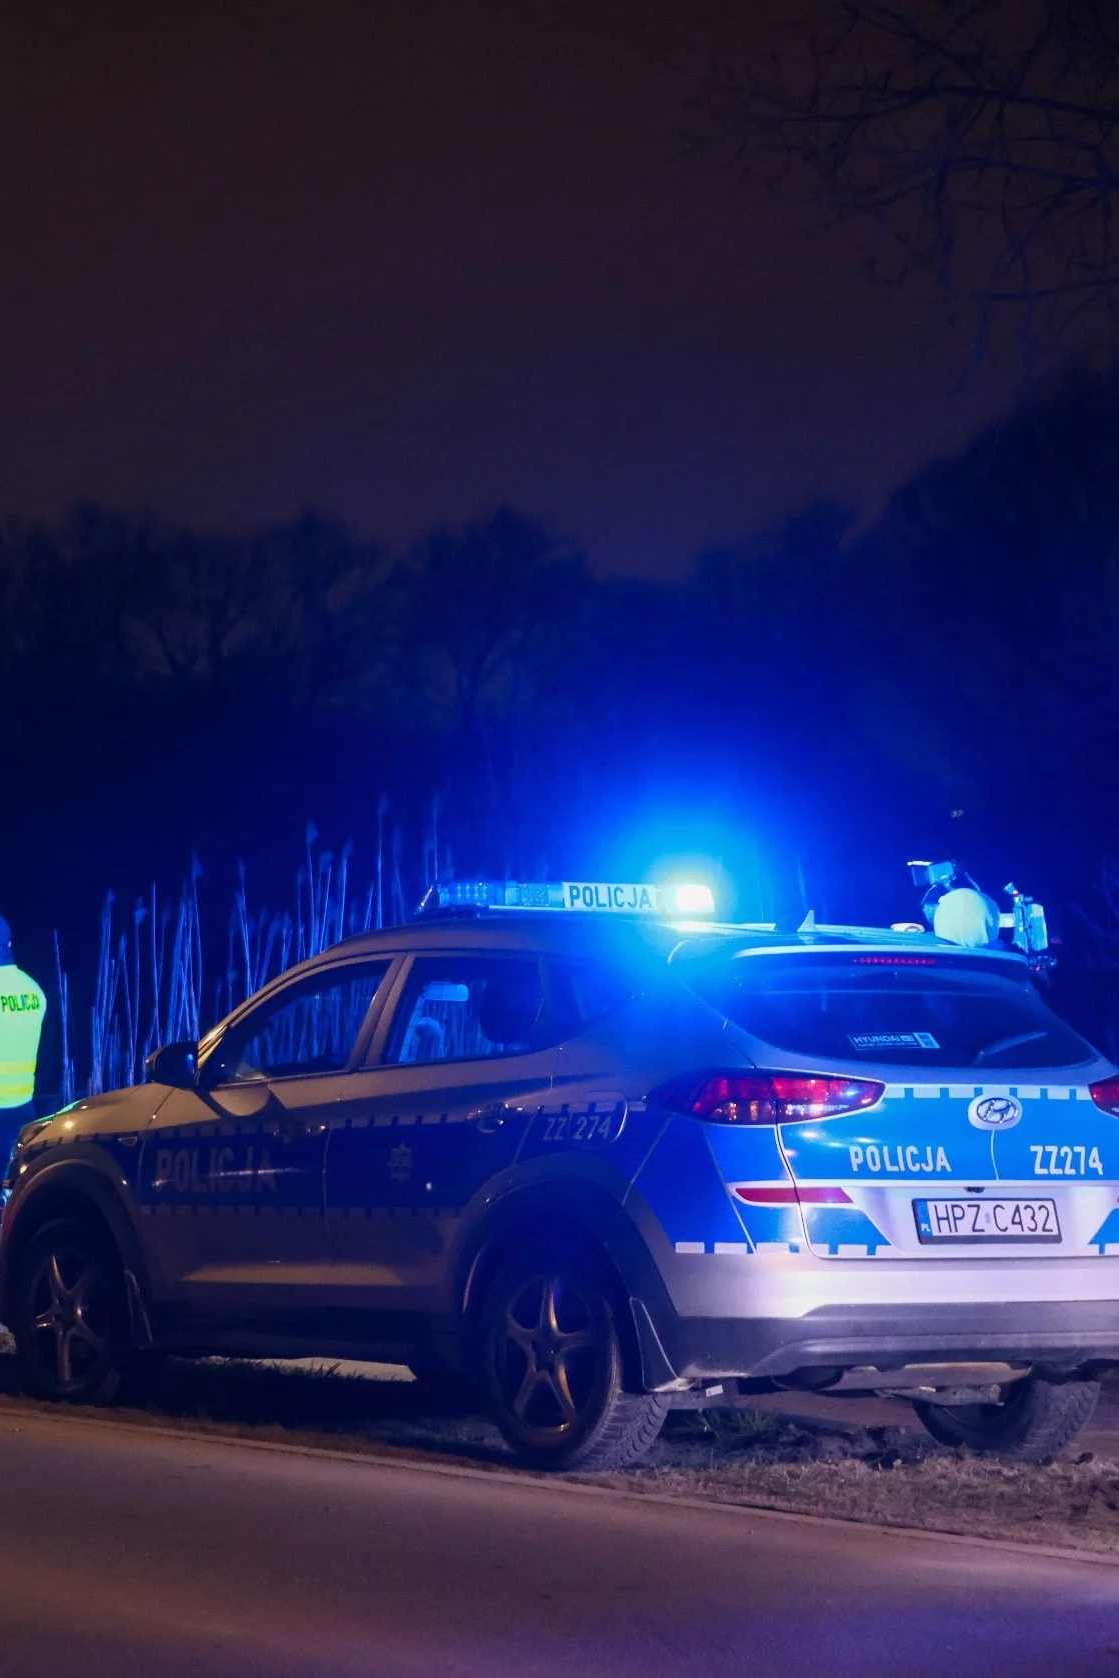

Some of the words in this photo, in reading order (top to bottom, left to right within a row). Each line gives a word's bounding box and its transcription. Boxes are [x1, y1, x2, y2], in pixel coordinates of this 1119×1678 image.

[568, 885, 653, 909] POLICJA
[0, 993, 40, 1012] POLICJA
[853, 1035, 900, 1044] HYUNDAI
[542, 1116, 567, 1141] ZZ
[572, 1115, 612, 1140] 274
[153, 1147, 278, 1193] POLICJA
[849, 1145, 953, 1173] POLICJA
[1030, 1145, 1104, 1176] ZZ274
[933, 1203, 986, 1234] HPZ
[992, 1203, 1054, 1233] C432
